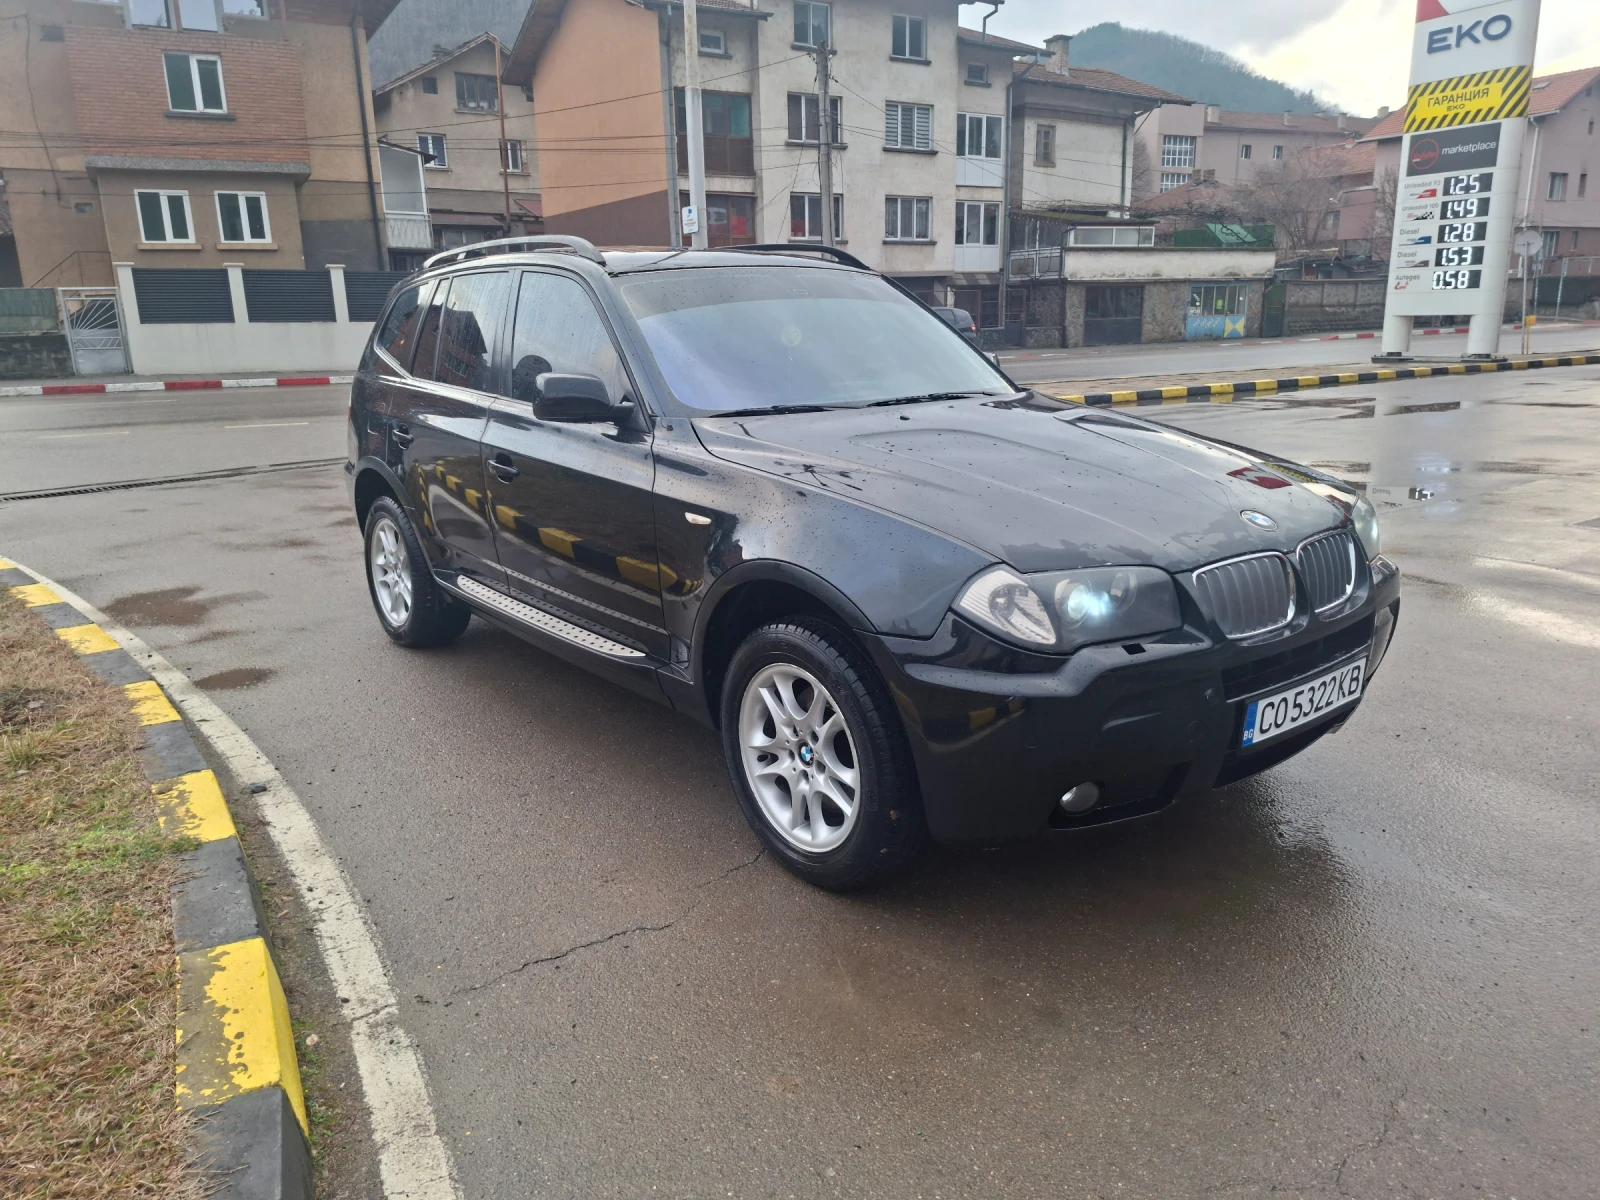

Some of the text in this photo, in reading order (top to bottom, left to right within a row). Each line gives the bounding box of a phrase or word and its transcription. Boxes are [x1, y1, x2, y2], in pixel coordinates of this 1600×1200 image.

[1426, 14, 1512, 54] EKO
[1427, 87, 1490, 108] ГАРАНЦИЯ
[1441, 141, 1497, 155] marketplace
[1404, 181, 1431, 189] Unleaded
[1449, 173, 1480, 195] 1.25
[1446, 198, 1478, 219] 1.49
[1444, 222, 1475, 243] 1.28
[1441, 246, 1473, 266] 1.53
[1395, 274, 1420, 282] Autogas
[1432, 270, 1470, 290] 0.58
[1243, 728, 1254, 740] BG
